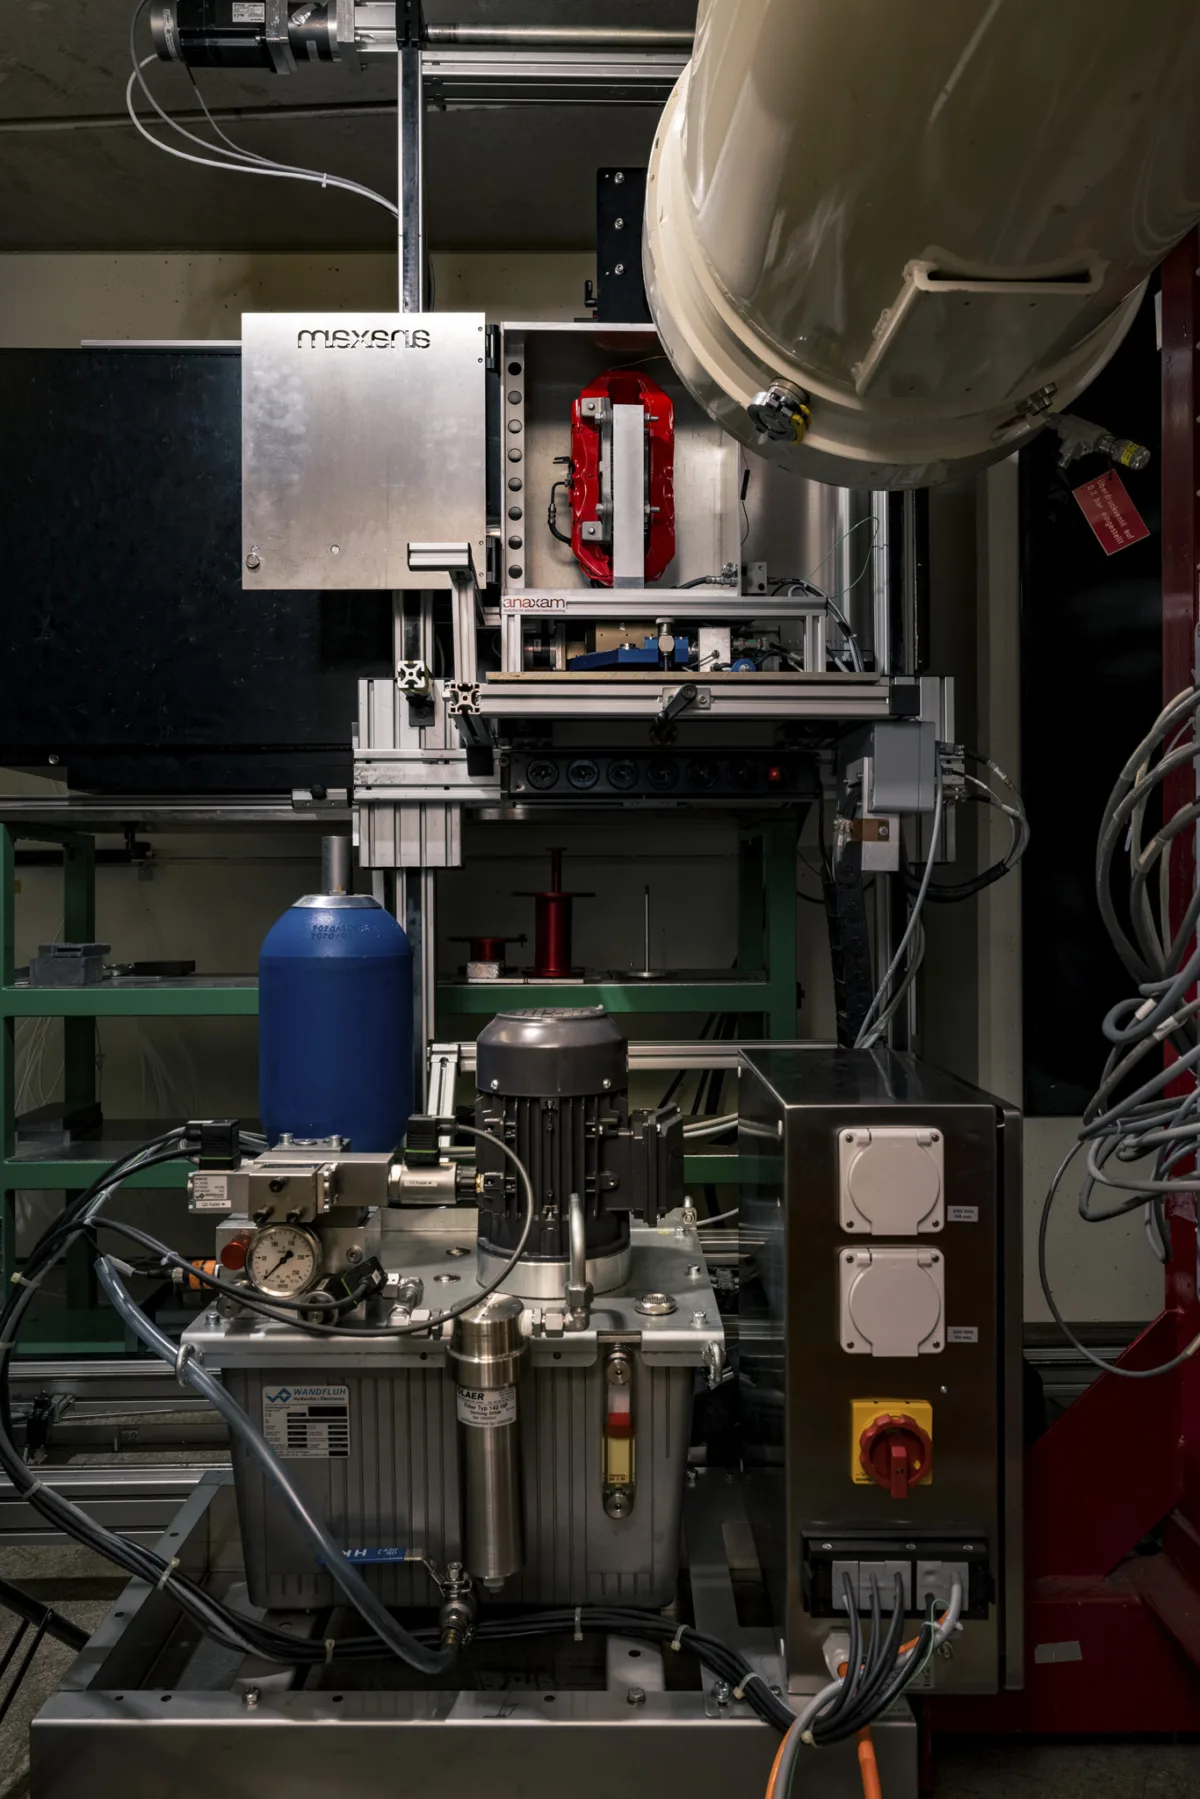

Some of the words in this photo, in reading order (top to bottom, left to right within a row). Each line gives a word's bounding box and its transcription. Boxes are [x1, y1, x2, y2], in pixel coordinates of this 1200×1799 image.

[1094, 498, 1103, 508] bar
[1101, 512, 1124, 544] eingestellt
[1097, 479, 1127, 527] Überdruckventil
[1124, 529, 1135, 540] auf
[503, 598, 566, 608] anaxam
